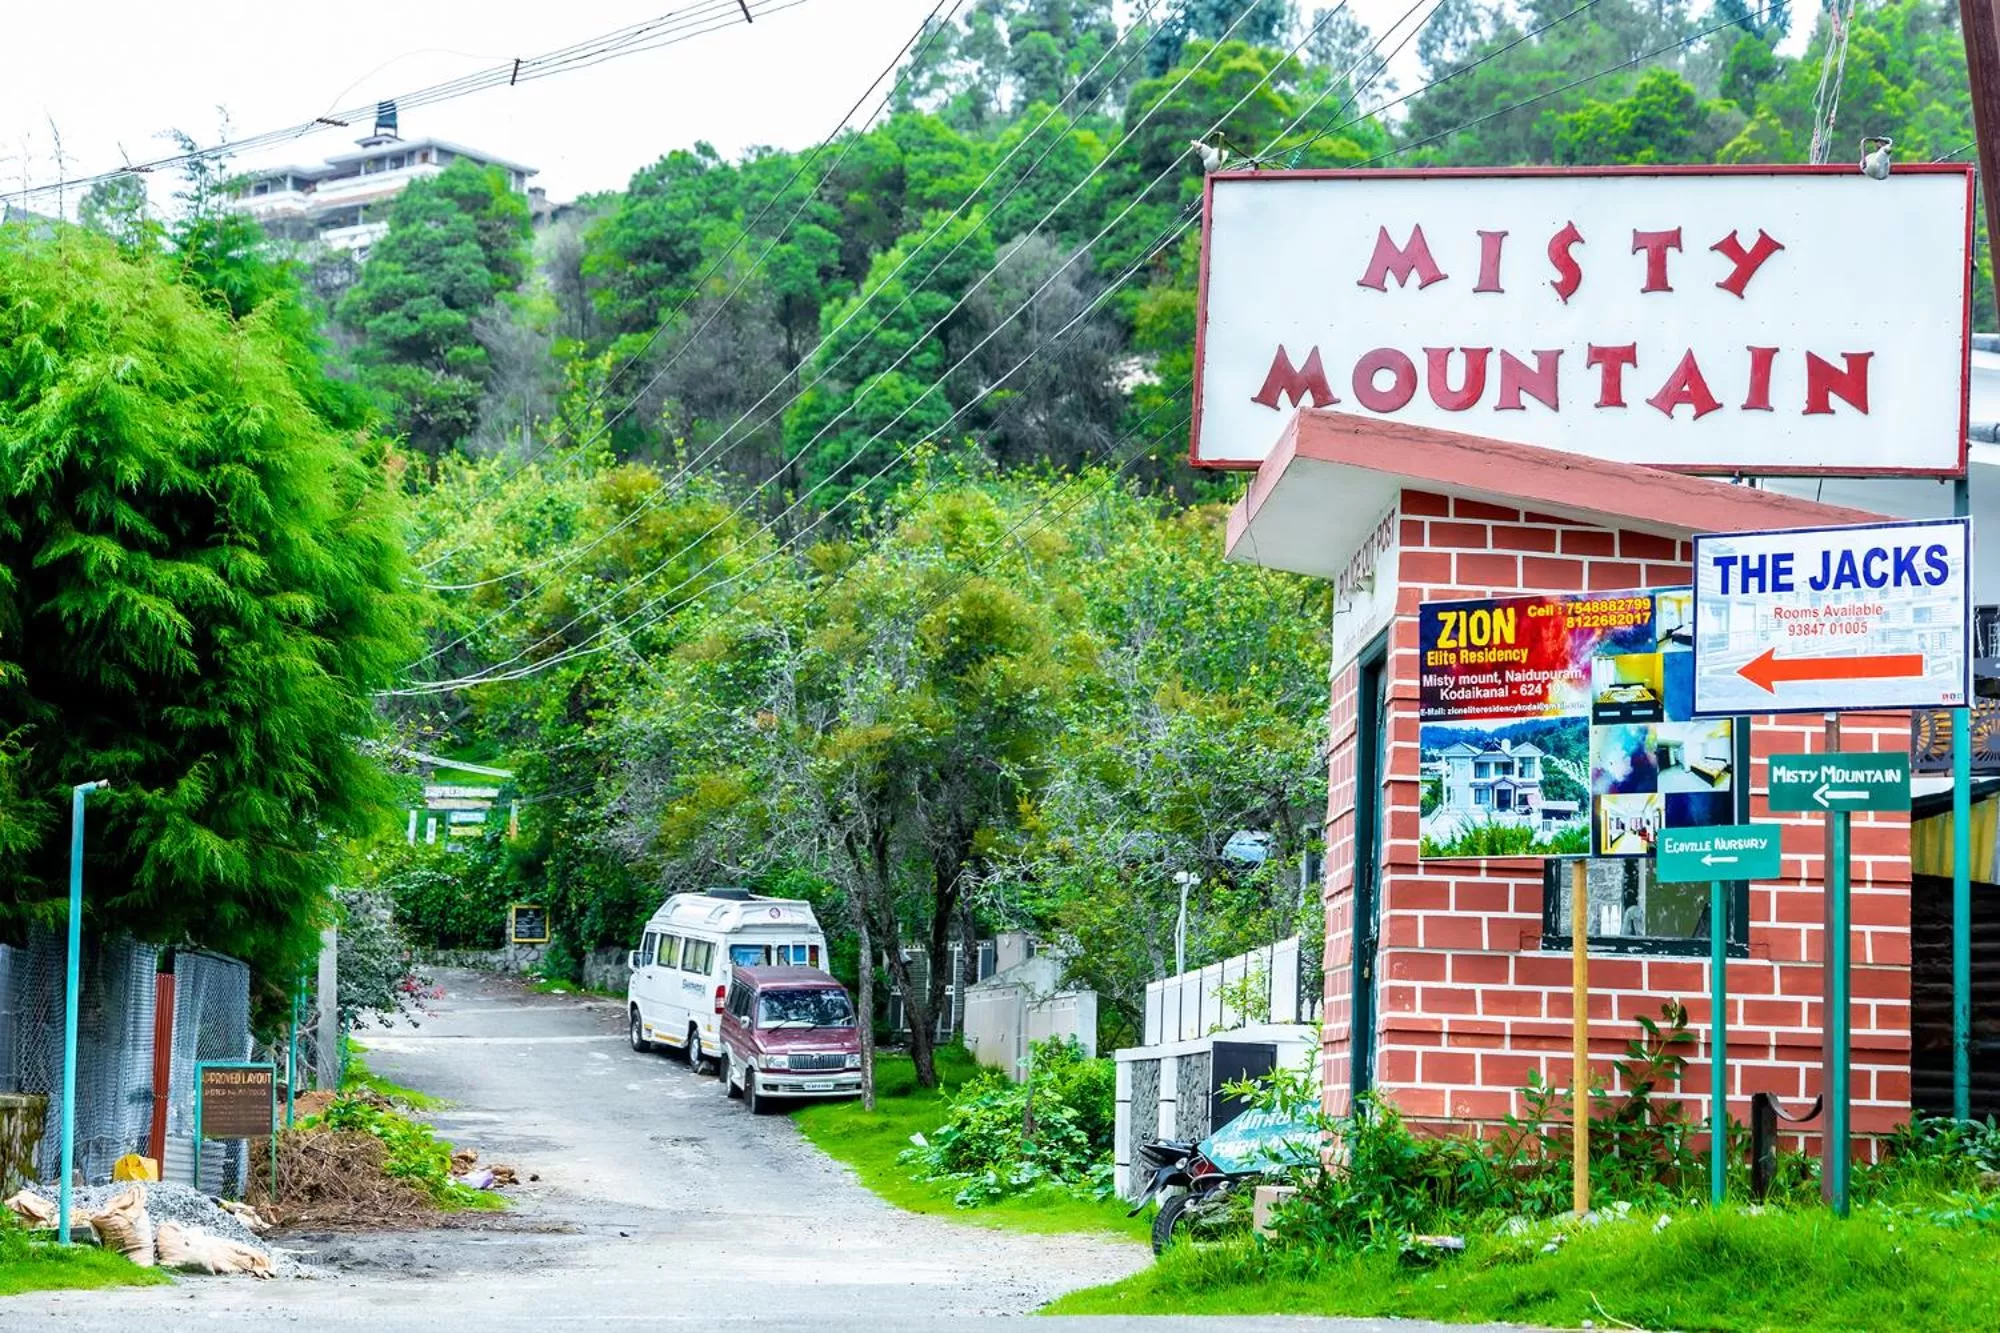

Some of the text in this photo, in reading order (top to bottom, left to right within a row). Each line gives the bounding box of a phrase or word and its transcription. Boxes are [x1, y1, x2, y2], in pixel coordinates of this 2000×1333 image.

[1357, 220, 1785, 304] MISTY
[1251, 341, 1875, 420] MOUNTAIN
[1713, 544, 1949, 595] THE JACKS
[1528, 604, 1554, 617] Cell
[1566, 598, 1651, 614] 7548882799
[1774, 602, 1883, 619] Rooms Available
[1437, 607, 1515, 648] ZION
[1566, 612, 1651, 628] 8122682017
[1788, 621, 1867, 637] 93847 01005
[1426, 646, 1528, 666] Elite Residency
[1422, 668, 1586, 689] Misty mount, Naidupuram,
[1440, 684, 1509, 701] Kodaikanal
[1519, 683, 1542, 697] 624
[1772, 765, 1901, 783] MISTY MOUNTAIN
